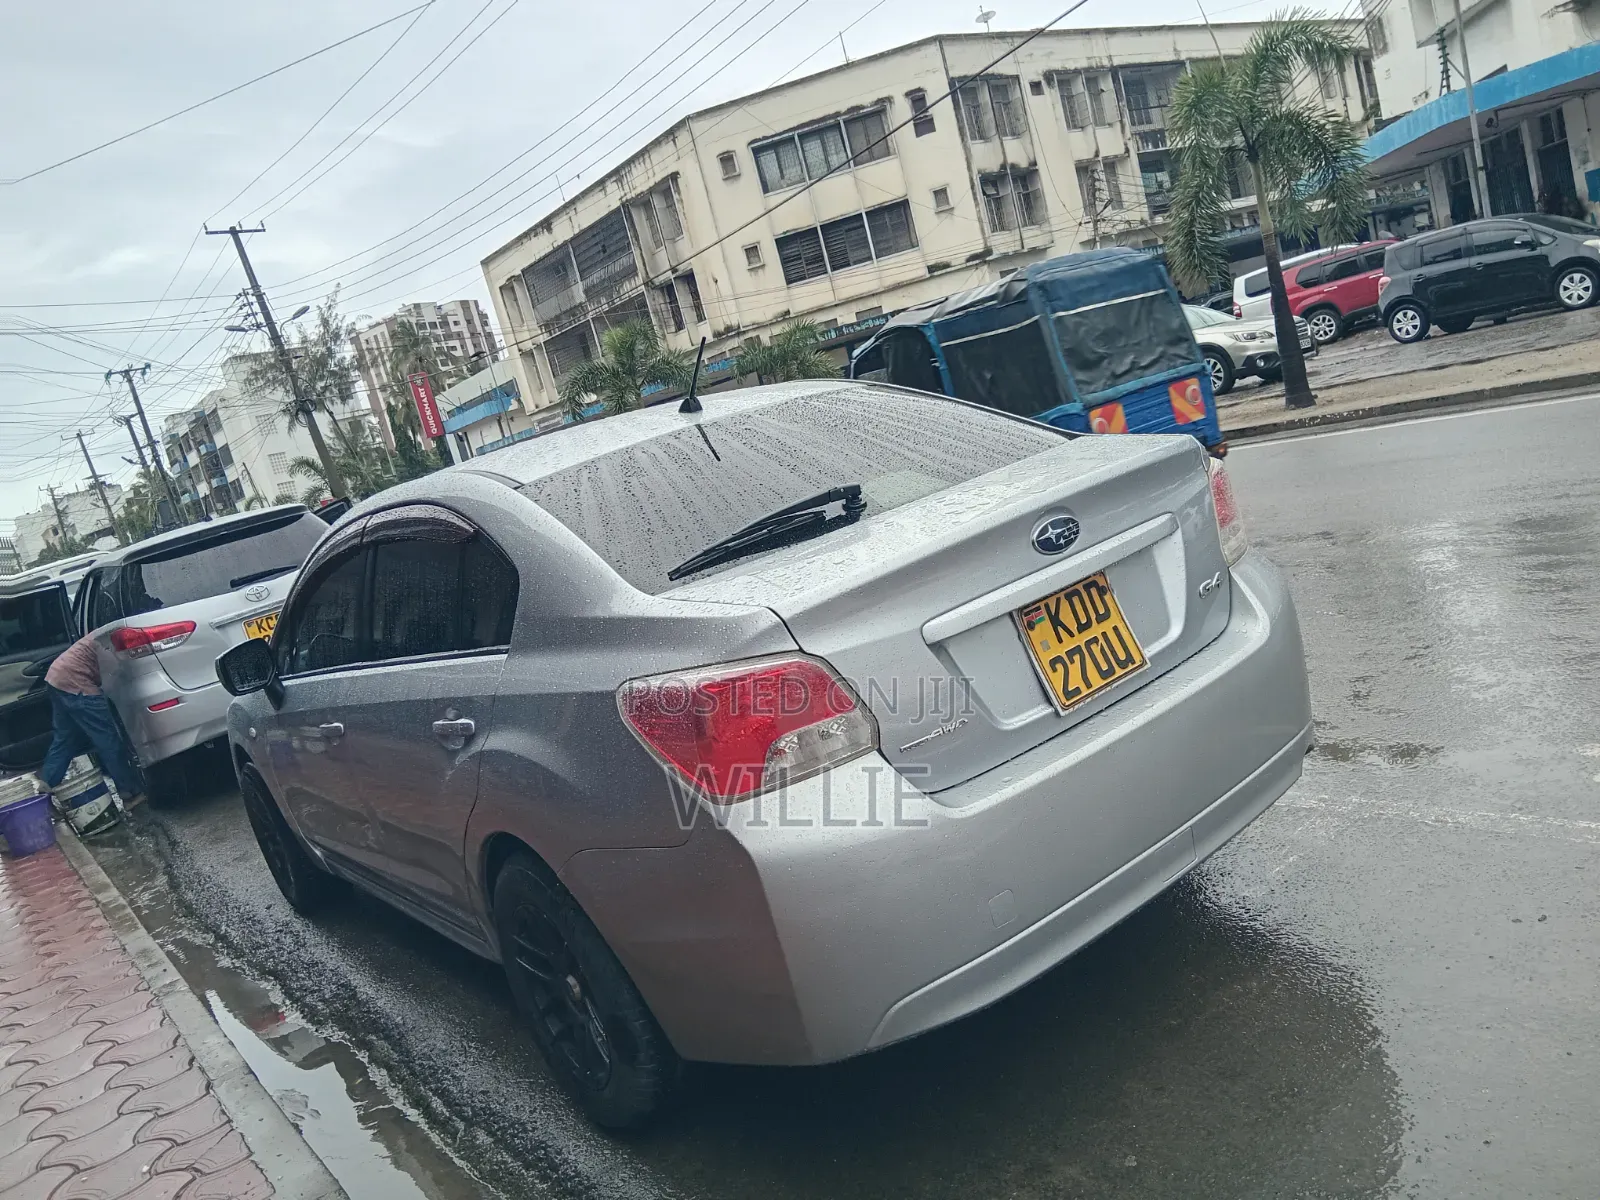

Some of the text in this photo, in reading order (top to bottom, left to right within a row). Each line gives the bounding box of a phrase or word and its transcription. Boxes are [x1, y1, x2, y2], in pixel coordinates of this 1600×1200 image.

[418, 387, 437, 434] QUICKMART
[1199, 571, 1221, 599] G4
[255, 613, 280, 634] KC
[1044, 580, 1111, 644] KDD
[1049, 625, 1136, 701] 270U
